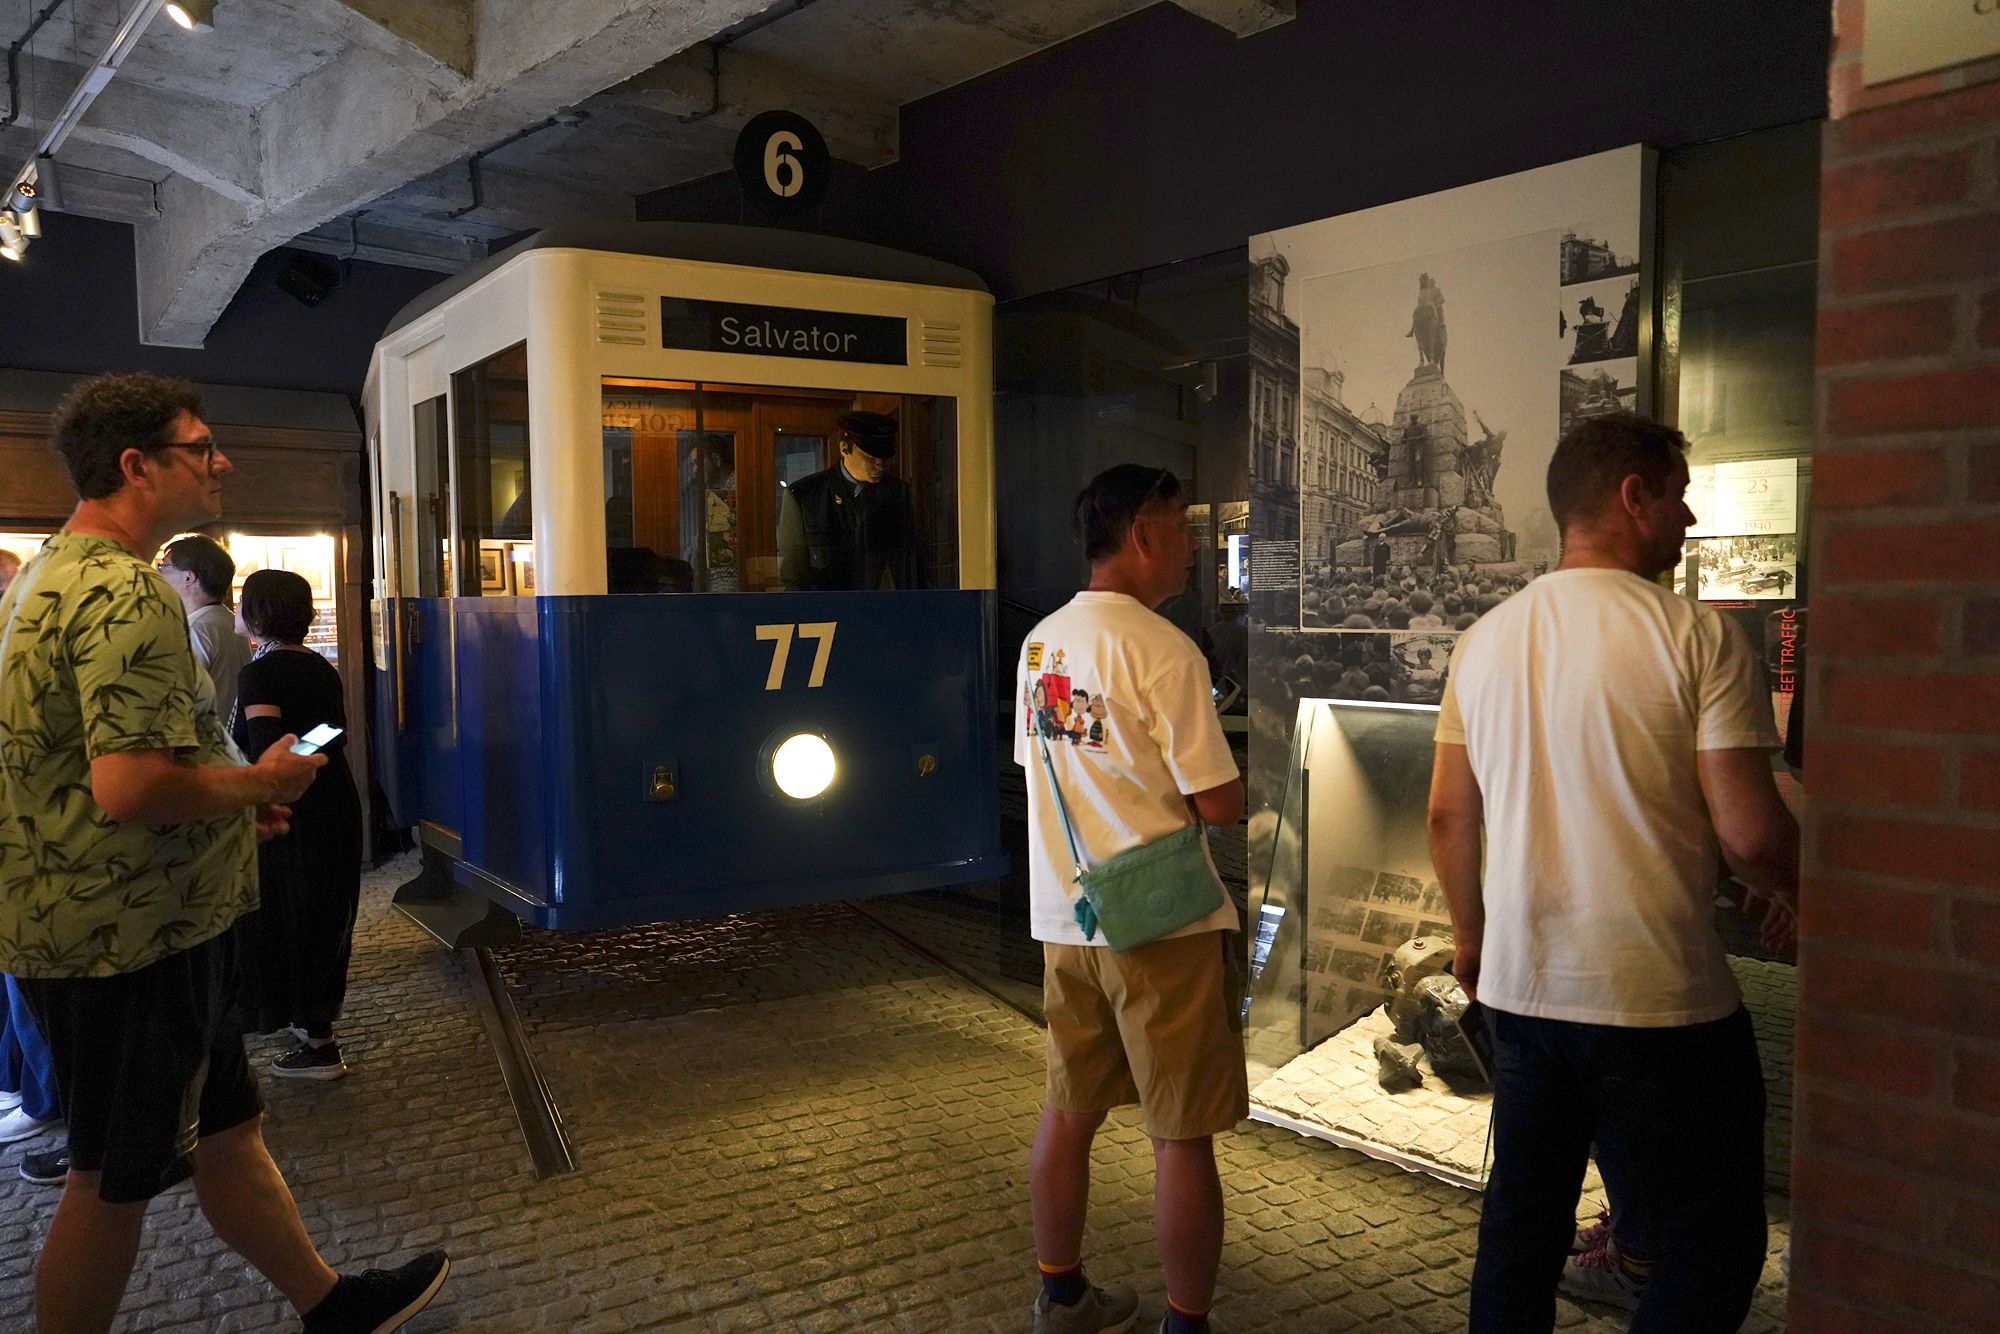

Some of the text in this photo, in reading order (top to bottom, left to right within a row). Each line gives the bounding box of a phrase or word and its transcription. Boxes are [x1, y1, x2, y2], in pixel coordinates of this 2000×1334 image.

[763, 130, 804, 198] 6
[720, 316, 858, 353] Salvator
[1746, 478, 1768, 494] 23
[1744, 521, 1772, 532] 1940
[755, 621, 838, 691] 77
[1780, 608, 1797, 665] TRAFFIC
